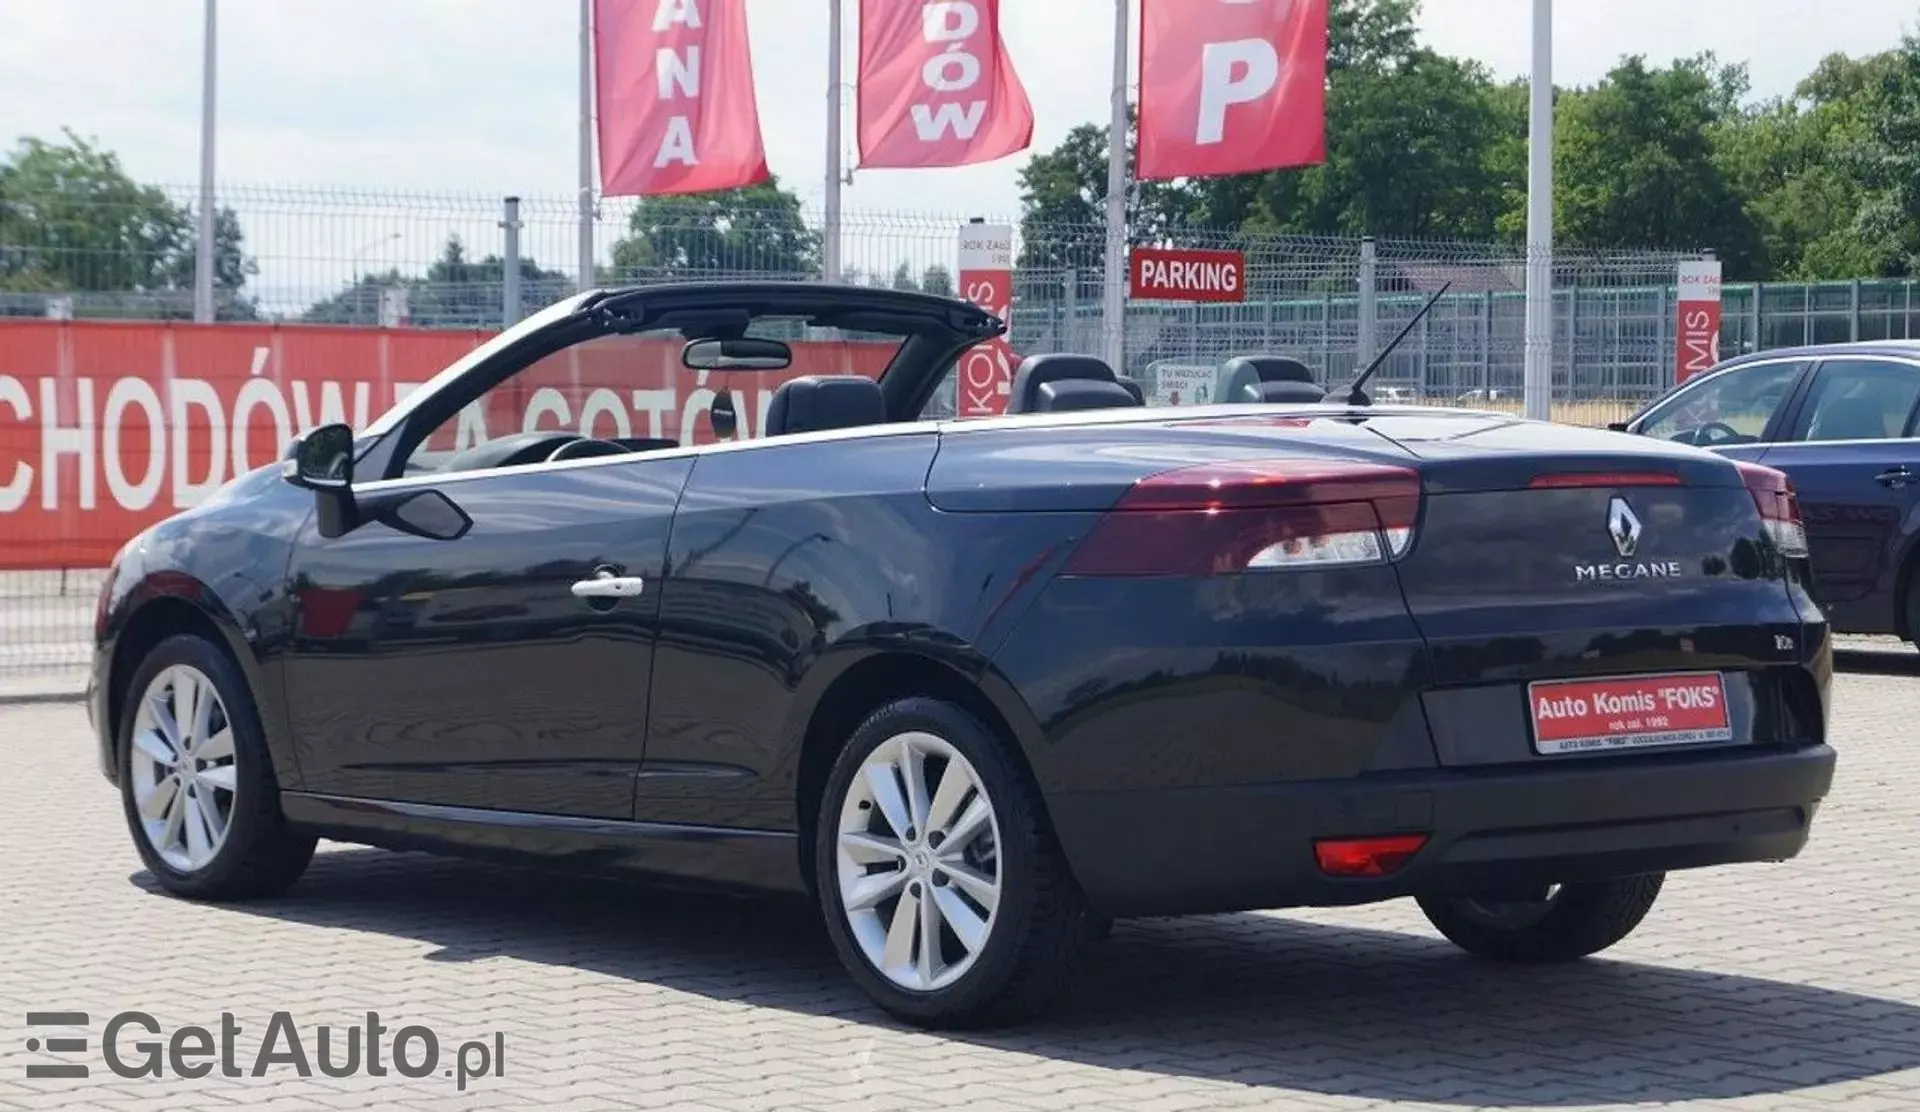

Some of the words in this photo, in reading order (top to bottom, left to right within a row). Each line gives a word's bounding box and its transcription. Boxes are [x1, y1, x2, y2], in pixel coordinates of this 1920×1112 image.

[1195, 0, 1278, 145] P
[1140, 259, 1238, 292] PARKING
[967, 281, 994, 412] KOIS
[1575, 562, 1681, 580] MEGANE
[1538, 698, 1588, 720] Auto
[1592, 689, 1657, 715] Komis
[1658, 686, 1719, 710] "FOKS"
[1608, 720, 1626, 730] rok
